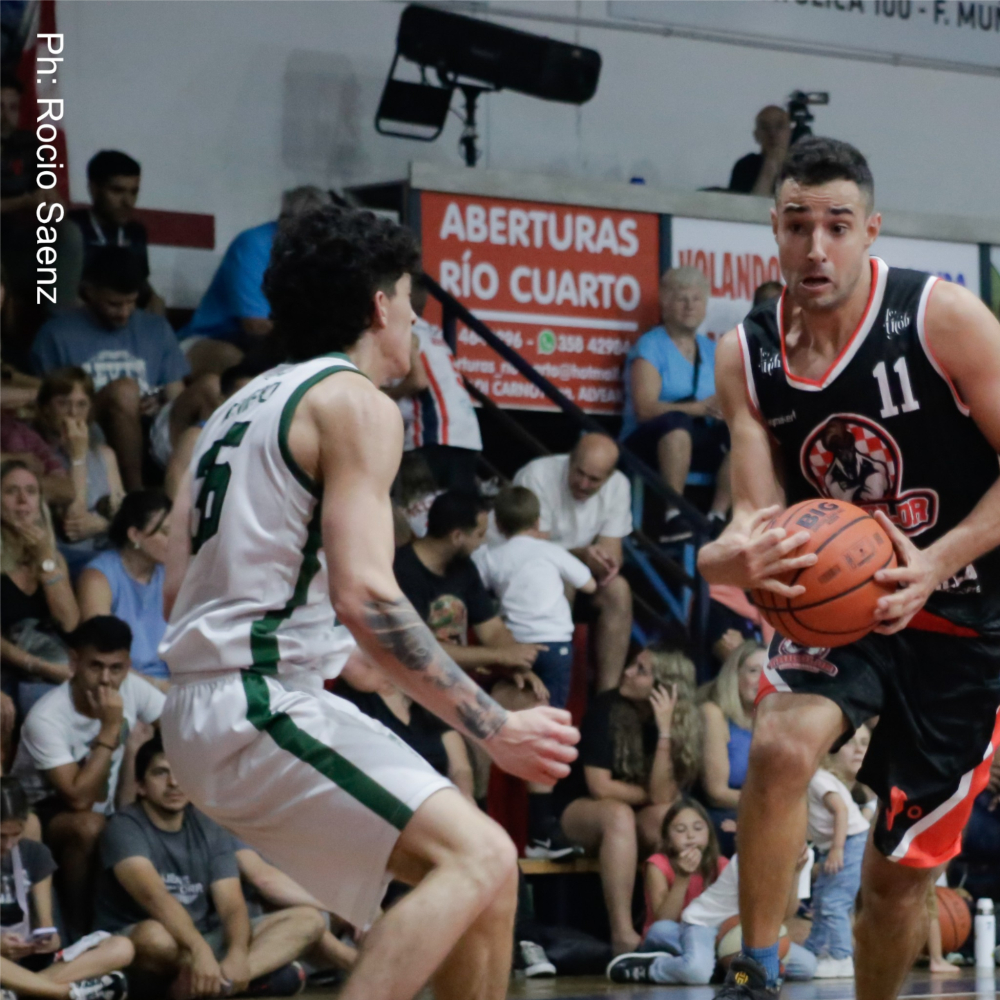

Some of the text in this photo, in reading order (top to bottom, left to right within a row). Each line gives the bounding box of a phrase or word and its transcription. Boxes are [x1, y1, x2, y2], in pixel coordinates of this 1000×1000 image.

[439, 201, 640, 257] ABERTURAS
[439, 248, 642, 312] RÍO CUARTO
[871, 356, 921, 419] 11
[795, 500, 840, 529] BIG
